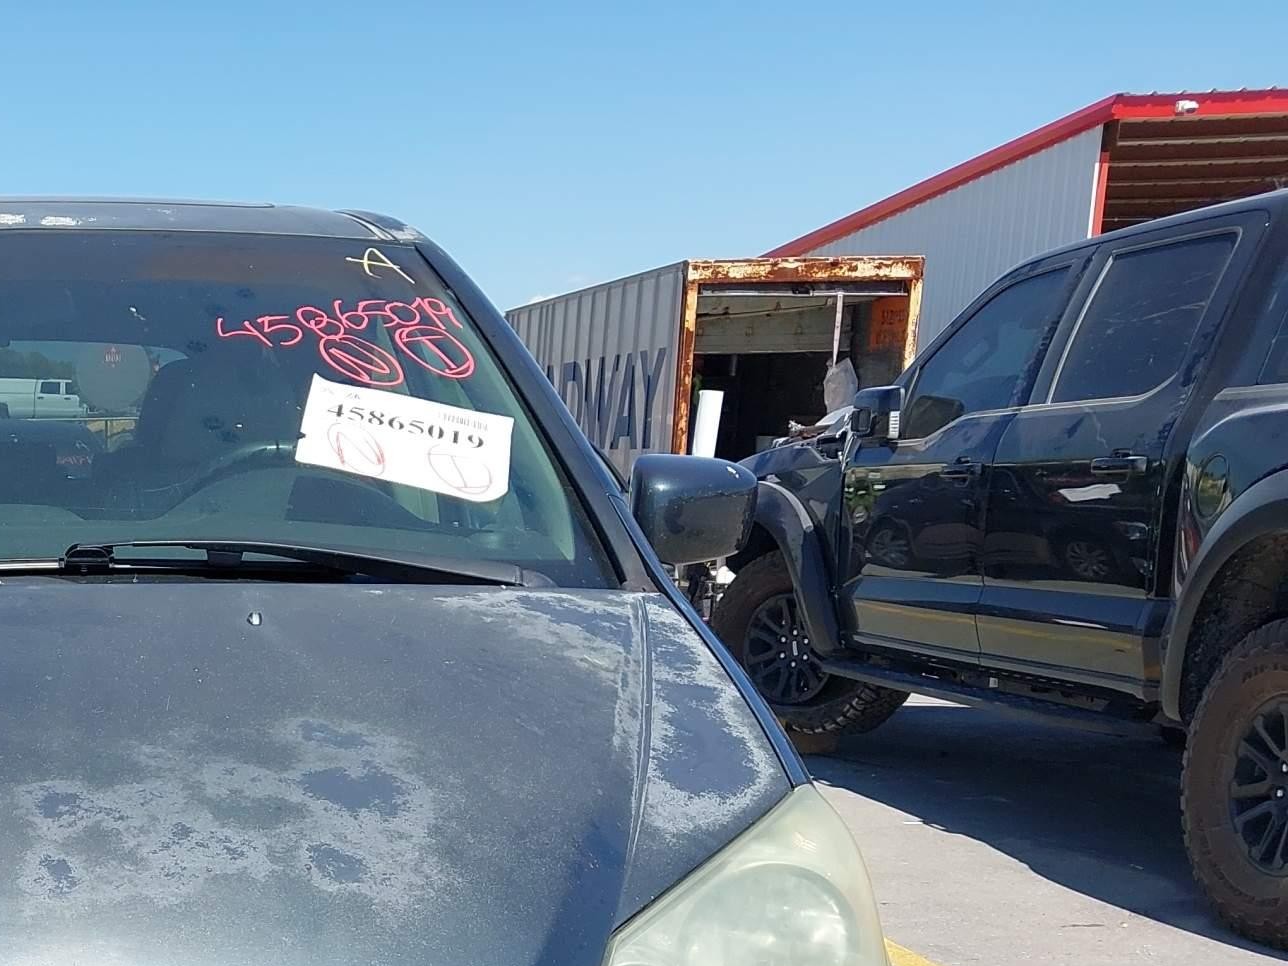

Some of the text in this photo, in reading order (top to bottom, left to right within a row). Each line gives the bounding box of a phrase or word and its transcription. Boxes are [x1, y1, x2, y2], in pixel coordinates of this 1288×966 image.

[217, 297, 463, 347] 45865019
[547, 348, 666, 449] DWAY
[327, 404, 484, 448] 45865019
